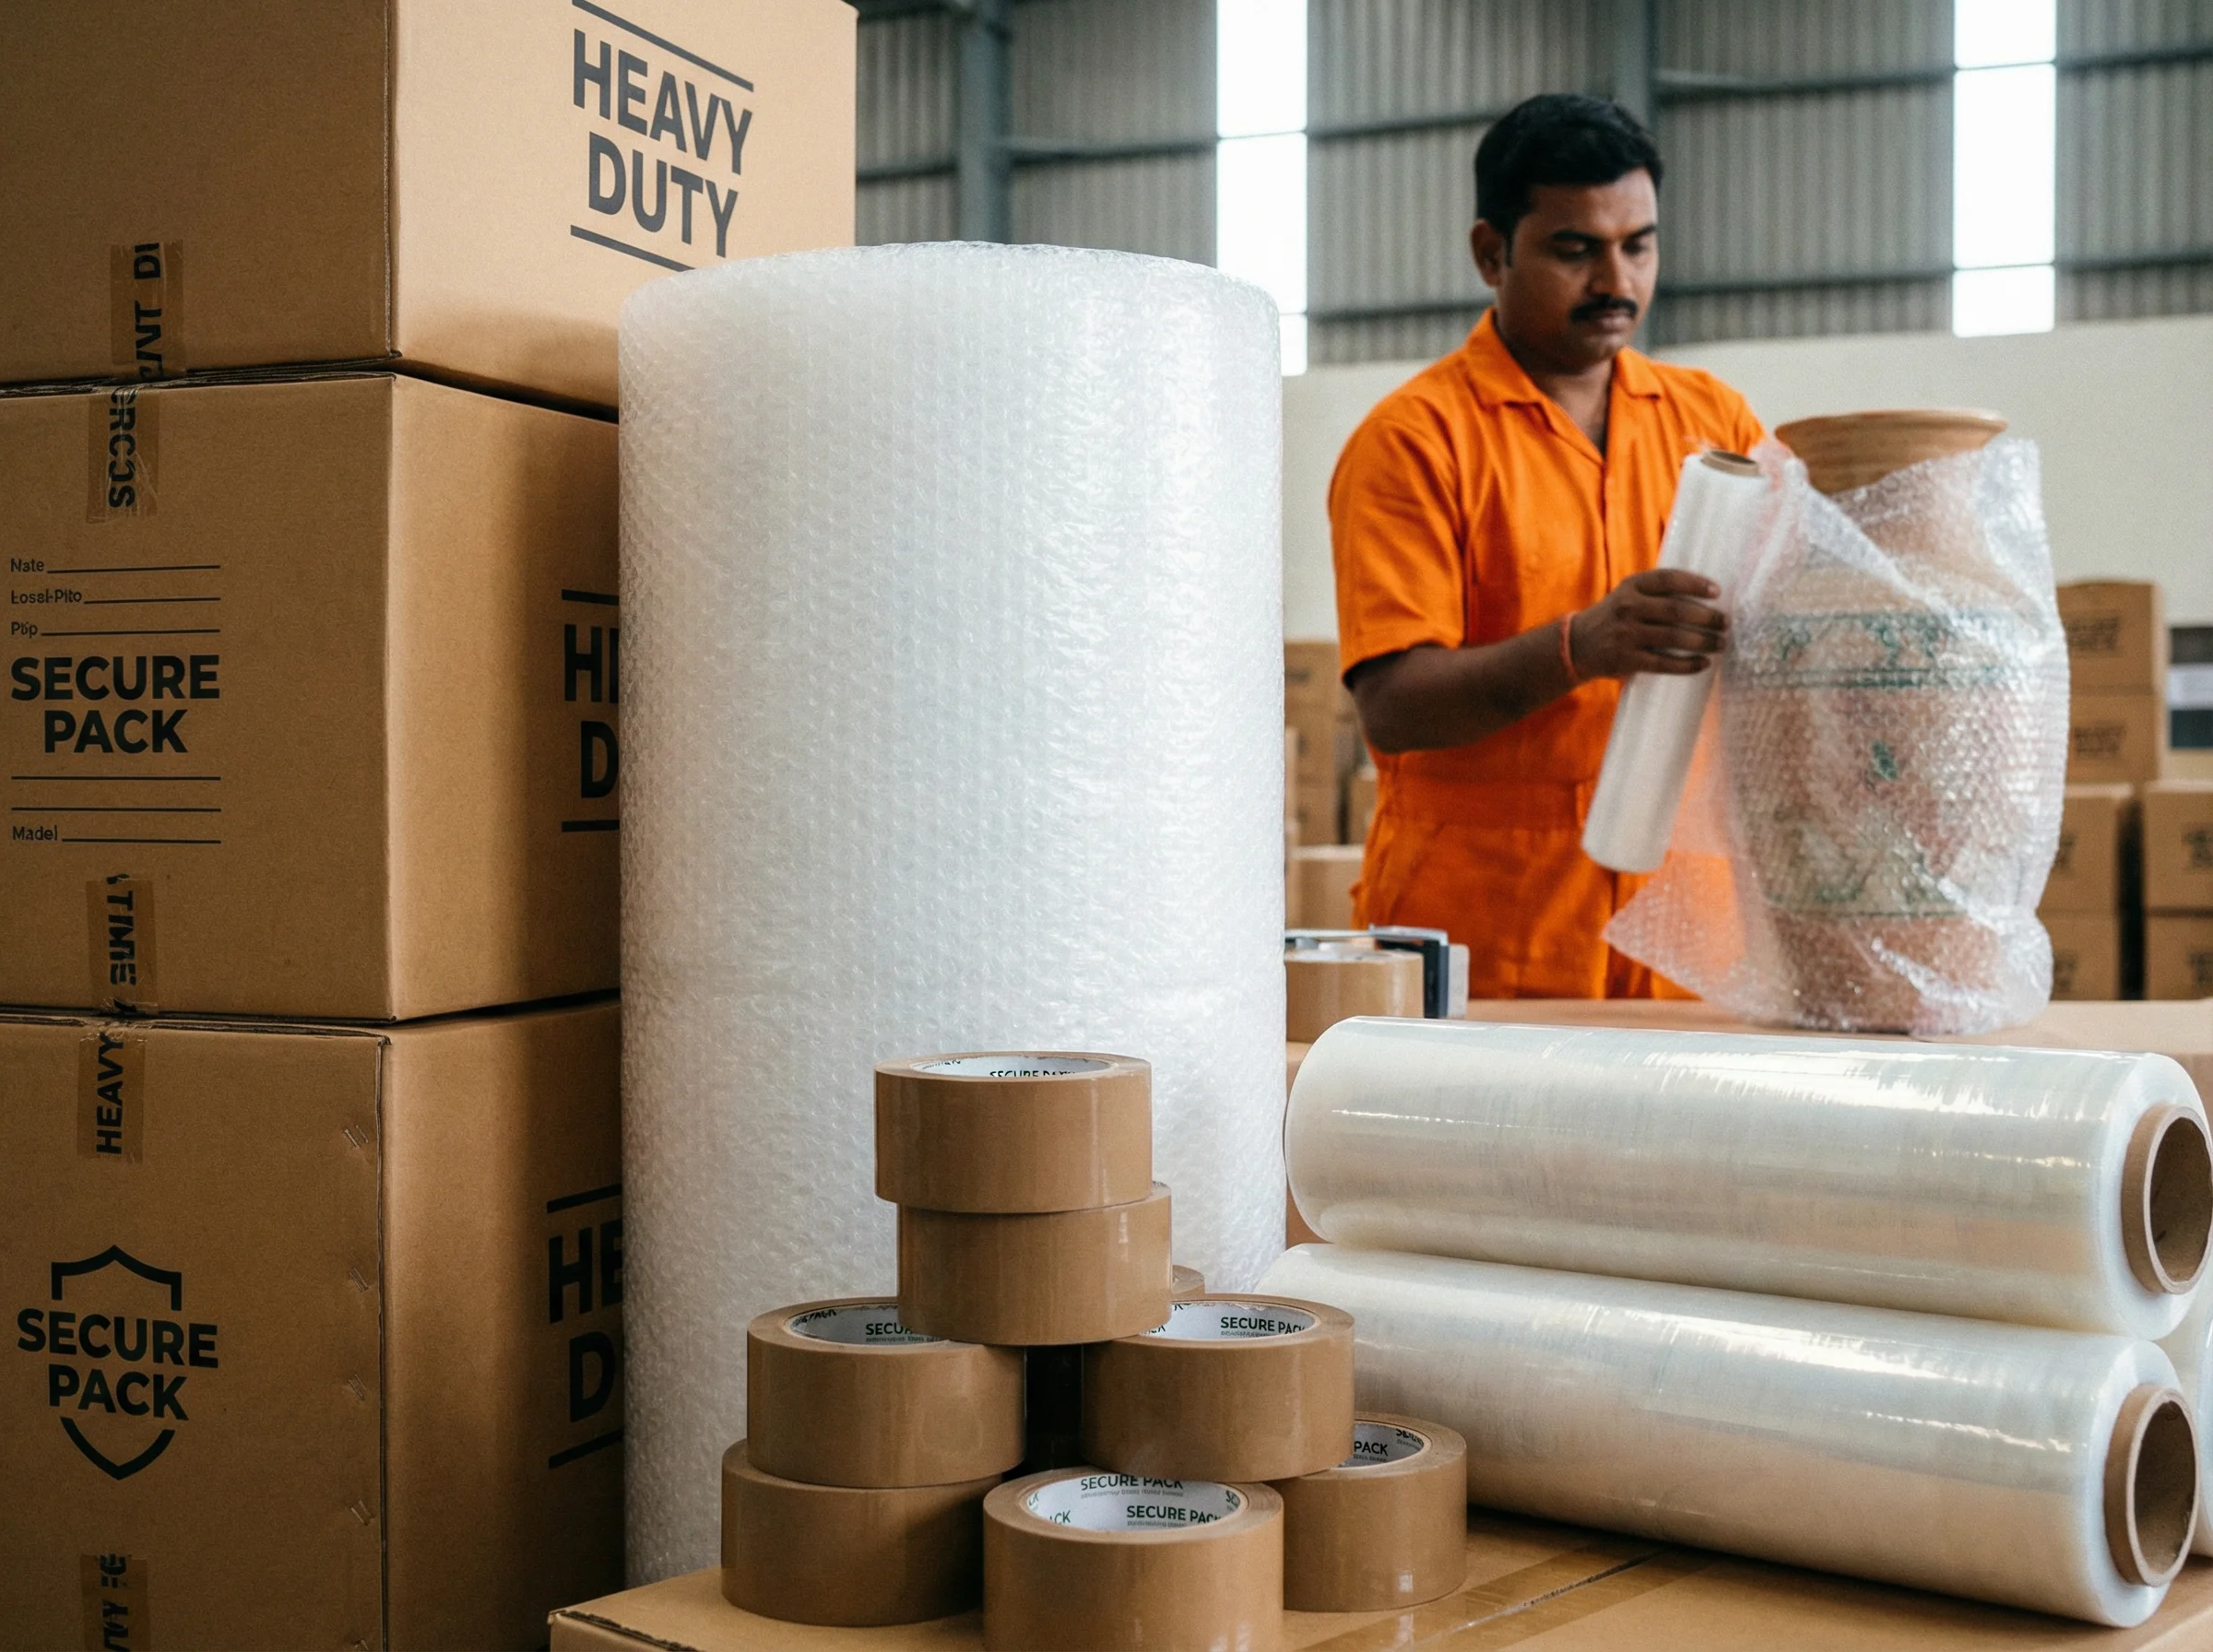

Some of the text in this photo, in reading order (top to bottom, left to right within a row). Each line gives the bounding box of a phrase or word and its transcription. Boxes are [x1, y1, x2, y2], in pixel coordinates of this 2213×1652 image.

[574, 28, 753, 175] HEAVY
[588, 131, 739, 258] DUTY
[11, 655, 220, 701] SECURE
[44, 709, 188, 753] PACK
[96, 1032, 124, 1154] HEAVY
[18, 1308, 219, 1368] SECURE
[1220, 1316, 1275, 1331] SECURE
[49, 1363, 189, 1421] PACK
[1354, 1441, 1389, 1457] PACK
[1081, 1475, 1140, 1491] SECURE
[1127, 1505, 1187, 1521] SECURE
